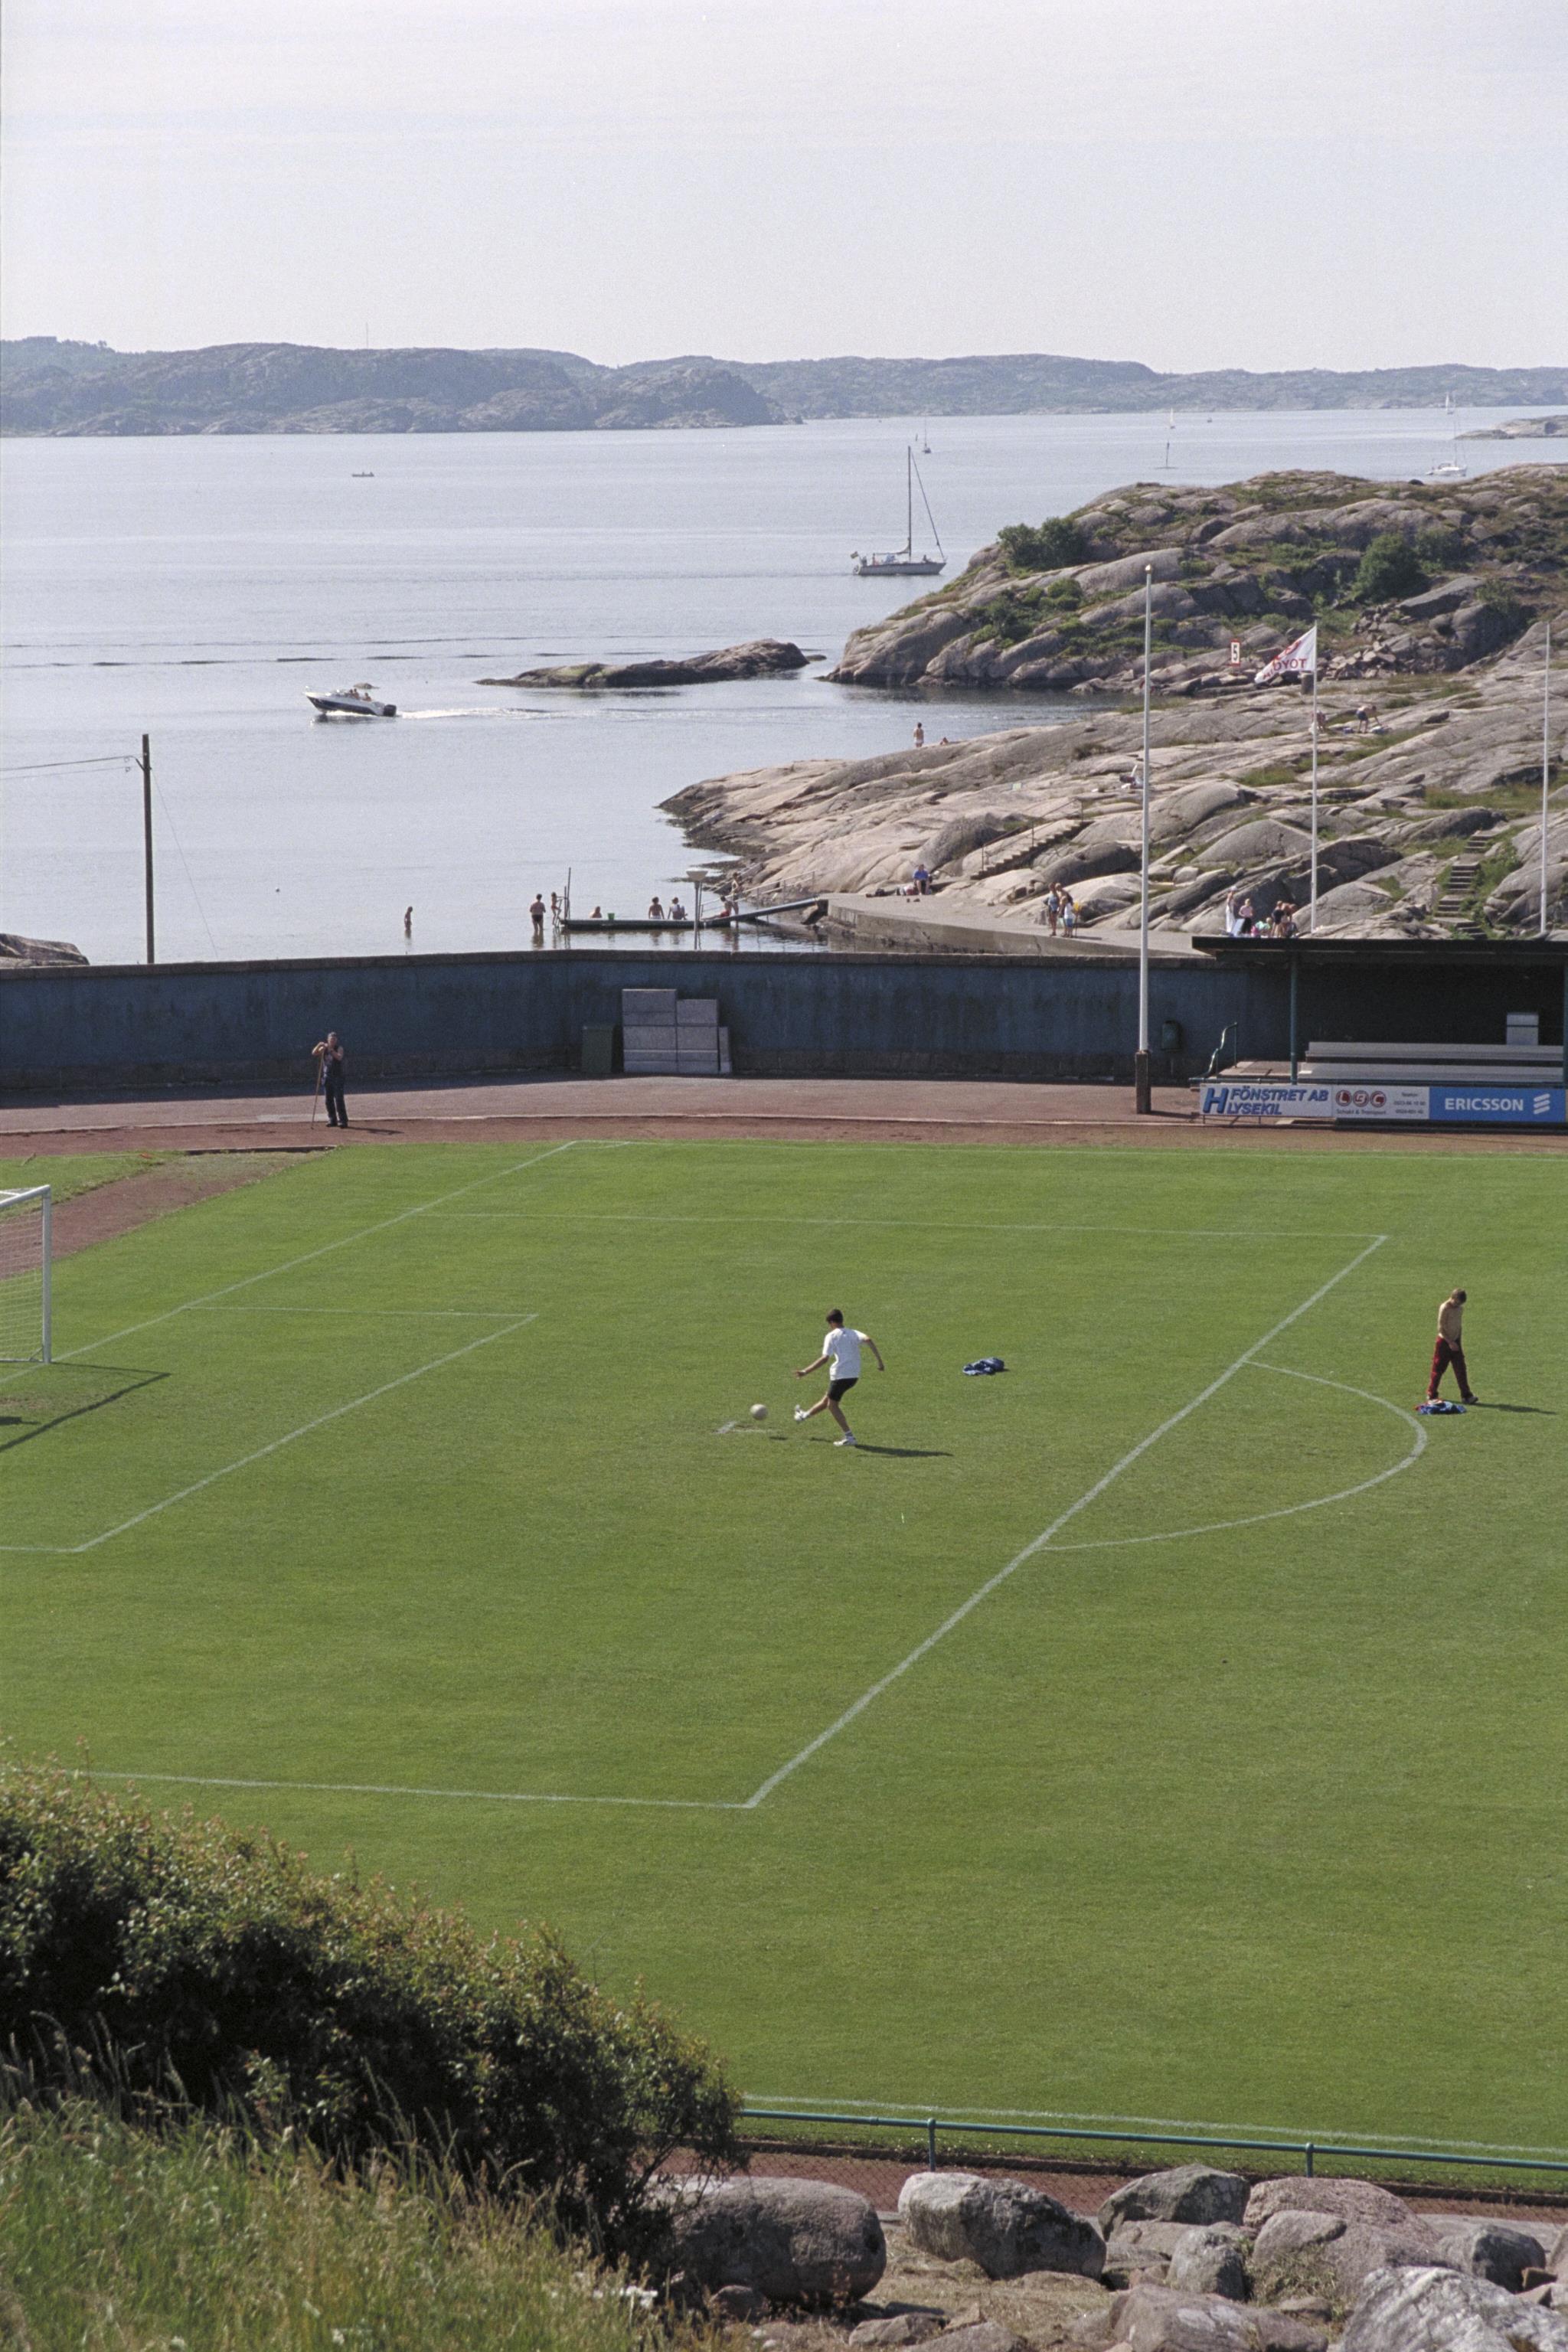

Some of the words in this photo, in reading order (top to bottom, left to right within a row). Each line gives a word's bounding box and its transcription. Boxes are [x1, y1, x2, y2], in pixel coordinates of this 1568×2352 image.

[1230, 1086, 1307, 1102] FÖNSTRET
[1308, 1089, 1330, 1102] AB
[1227, 1102, 1282, 1115] LYSEKIL
[1445, 1097, 1524, 1111] ERICSSON
